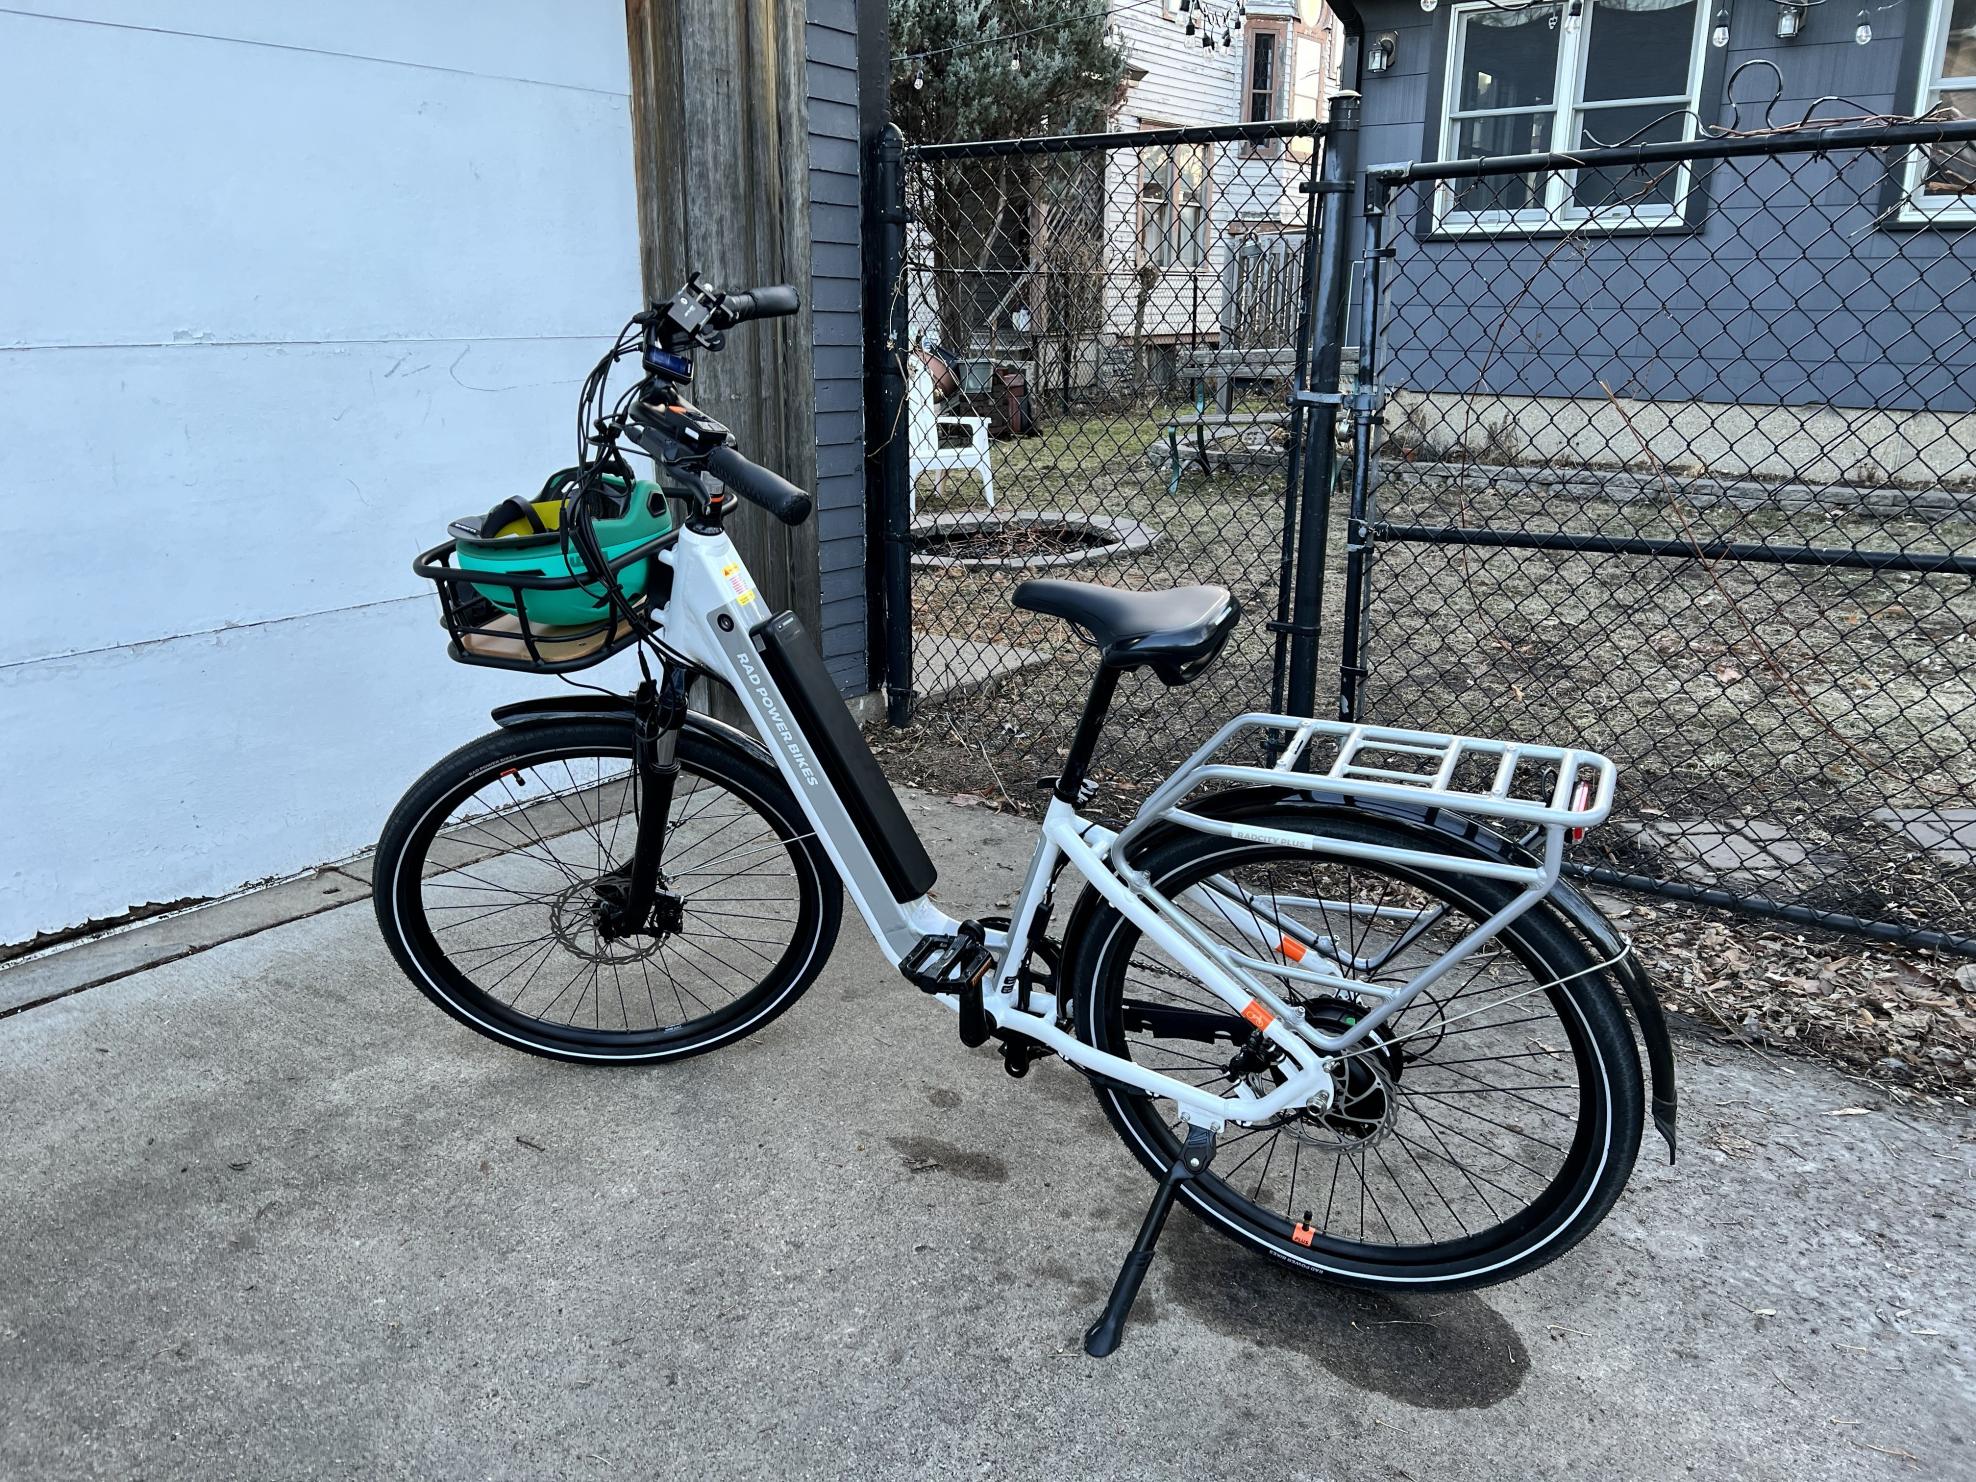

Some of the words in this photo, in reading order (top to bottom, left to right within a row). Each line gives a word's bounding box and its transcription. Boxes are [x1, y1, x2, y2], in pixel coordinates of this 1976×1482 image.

[737, 653, 760, 685] RAD
[755, 687, 793, 743] POWER
[787, 743, 818, 786] BIKES
[1237, 831, 1279, 844] RADCITY
[1281, 838, 1305, 848] PLUS
[1294, 1236, 1309, 1245] PLUS
[1287, 1258, 1310, 1270] POWER
[1310, 1266, 1324, 1274] RAD
